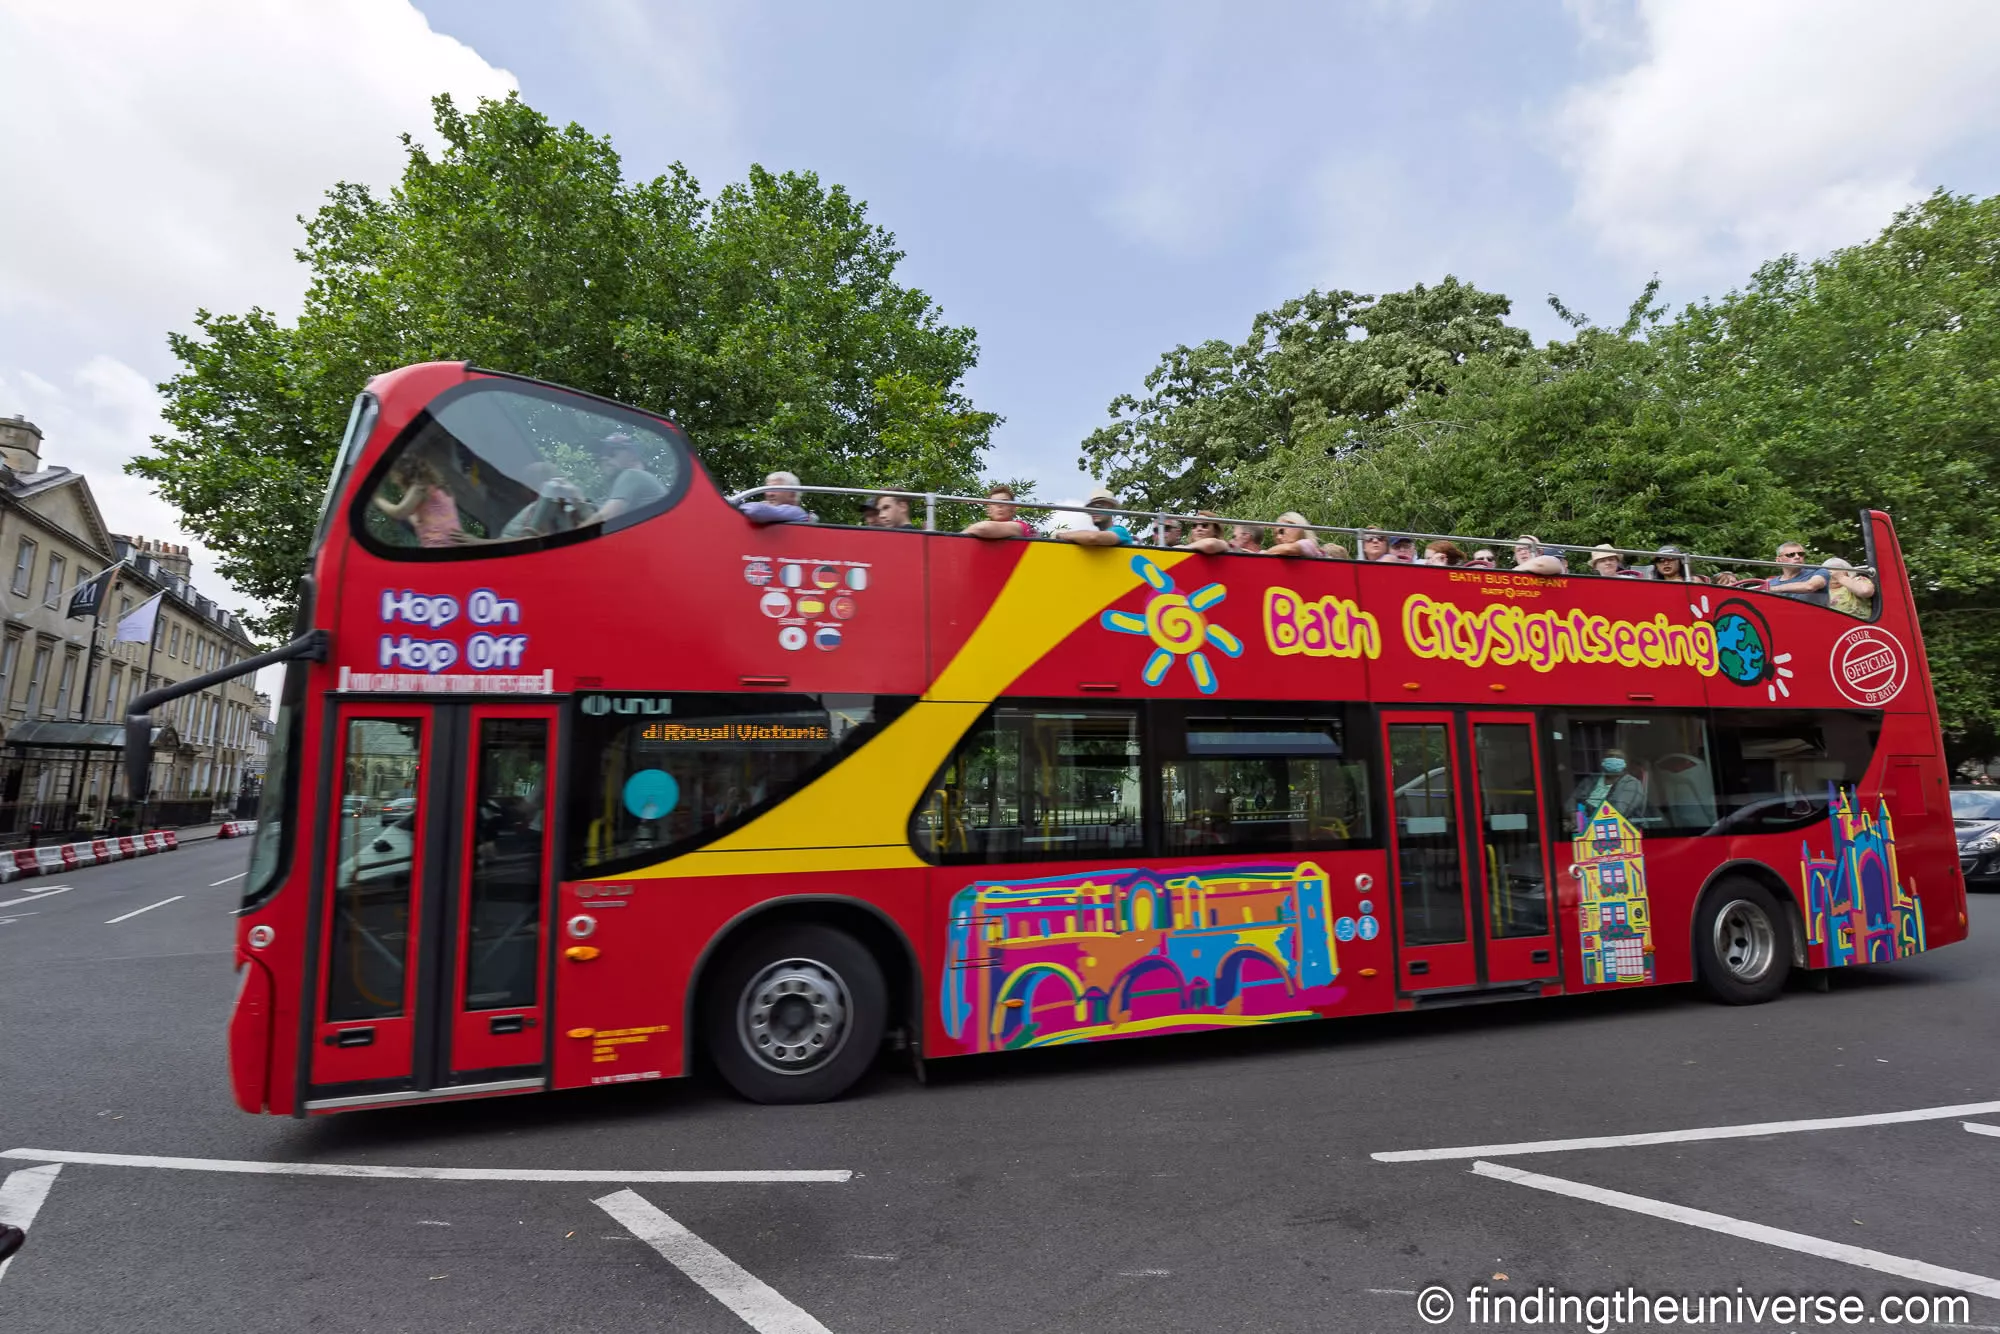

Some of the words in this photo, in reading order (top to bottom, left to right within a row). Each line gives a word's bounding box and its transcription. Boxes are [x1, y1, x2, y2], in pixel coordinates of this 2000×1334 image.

[1449, 572, 1481, 583] BATH
[1485, 574, 1510, 585] BUS
[1512, 575, 1569, 588] COMPANY
[381, 588, 459, 630] Hop
[467, 588, 520, 625] On
[1263, 587, 1382, 660] Bath
[1402, 594, 1719, 677] CitySightseeing
[1846, 631, 1870, 645] TOUR
[379, 634, 458, 675] Hop
[466, 632, 529, 670] Off
[1847, 652, 1894, 679] OFFICIAL
[1866, 692, 1877, 702] OF
[1879, 682, 1897, 700] BATH
[664, 724, 729, 741] Royal
